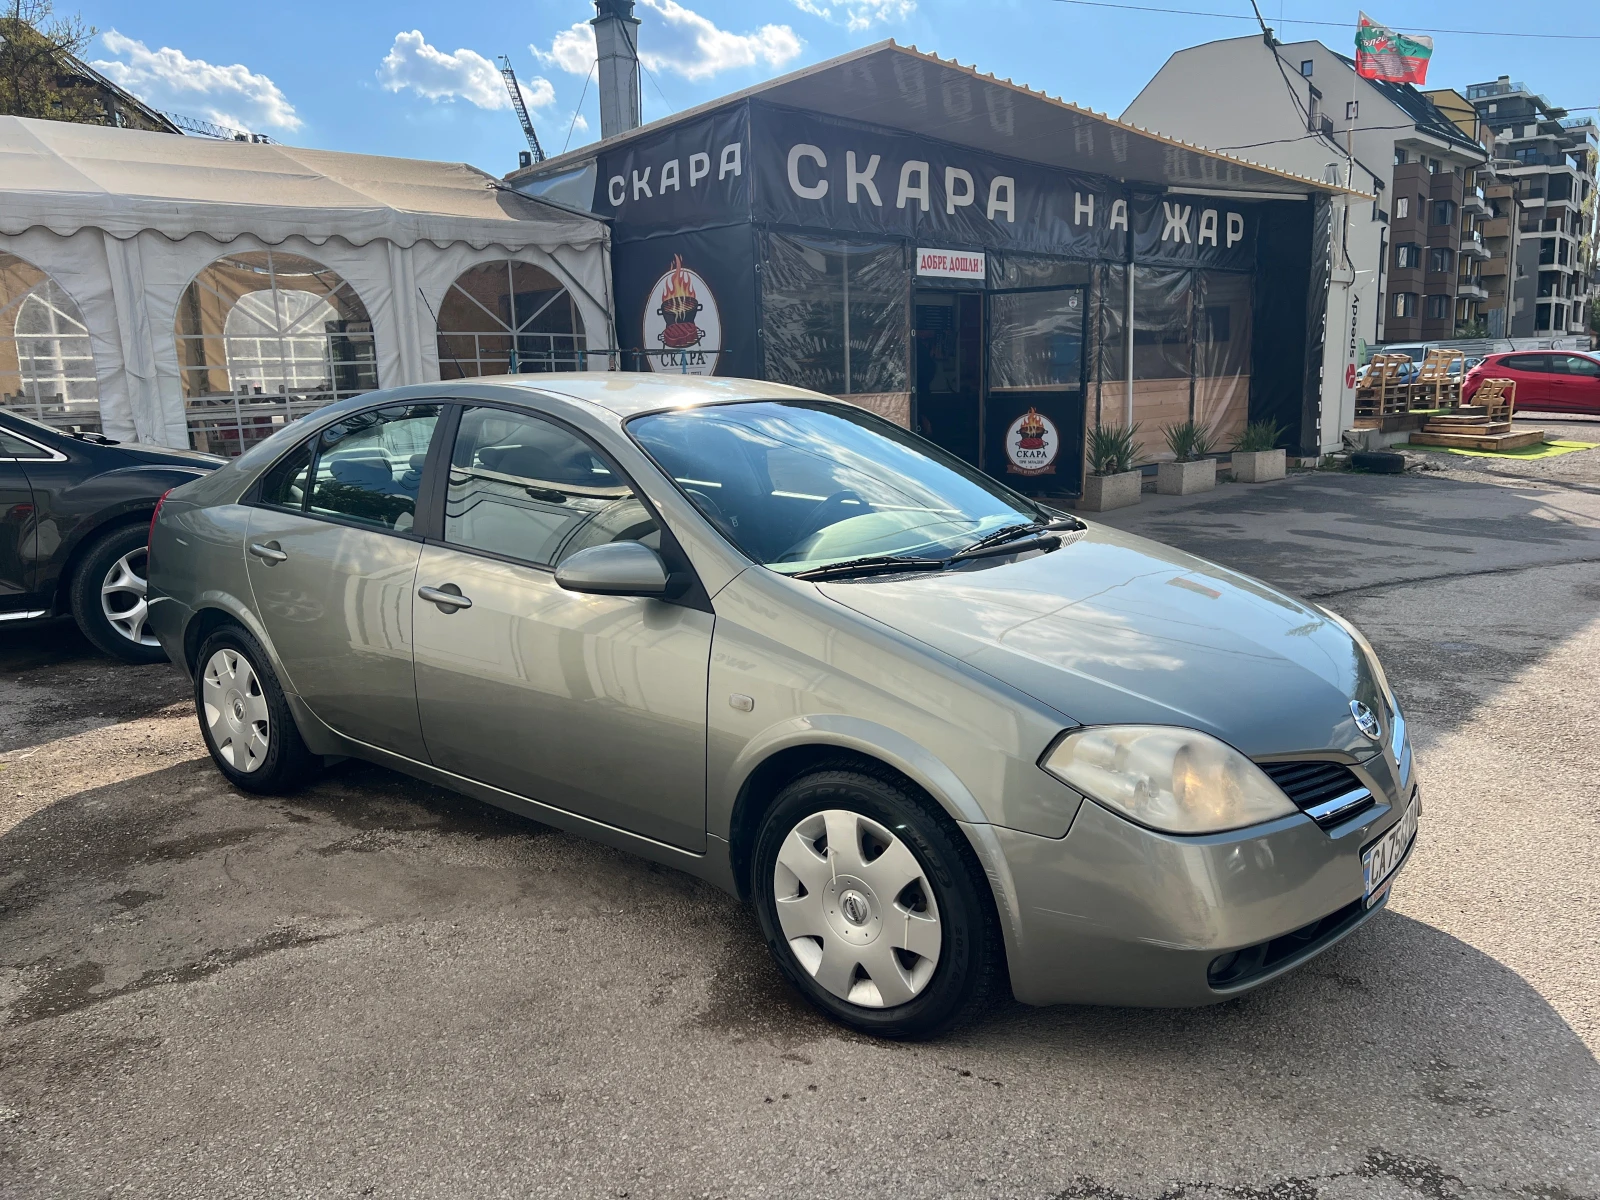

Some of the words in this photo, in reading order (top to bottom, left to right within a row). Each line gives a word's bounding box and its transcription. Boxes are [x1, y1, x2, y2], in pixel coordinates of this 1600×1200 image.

[608, 142, 742, 206] СКАРА
[787, 143, 1014, 223] СКАРА
[1074, 191, 1128, 232] НА
[1161, 201, 1244, 248] ЖАР
[921, 254, 947, 271] ДОБРЕ
[1349, 294, 1360, 358] speedy
[1016, 450, 1047, 458] СКАРА
[1371, 842, 1386, 885] CA
